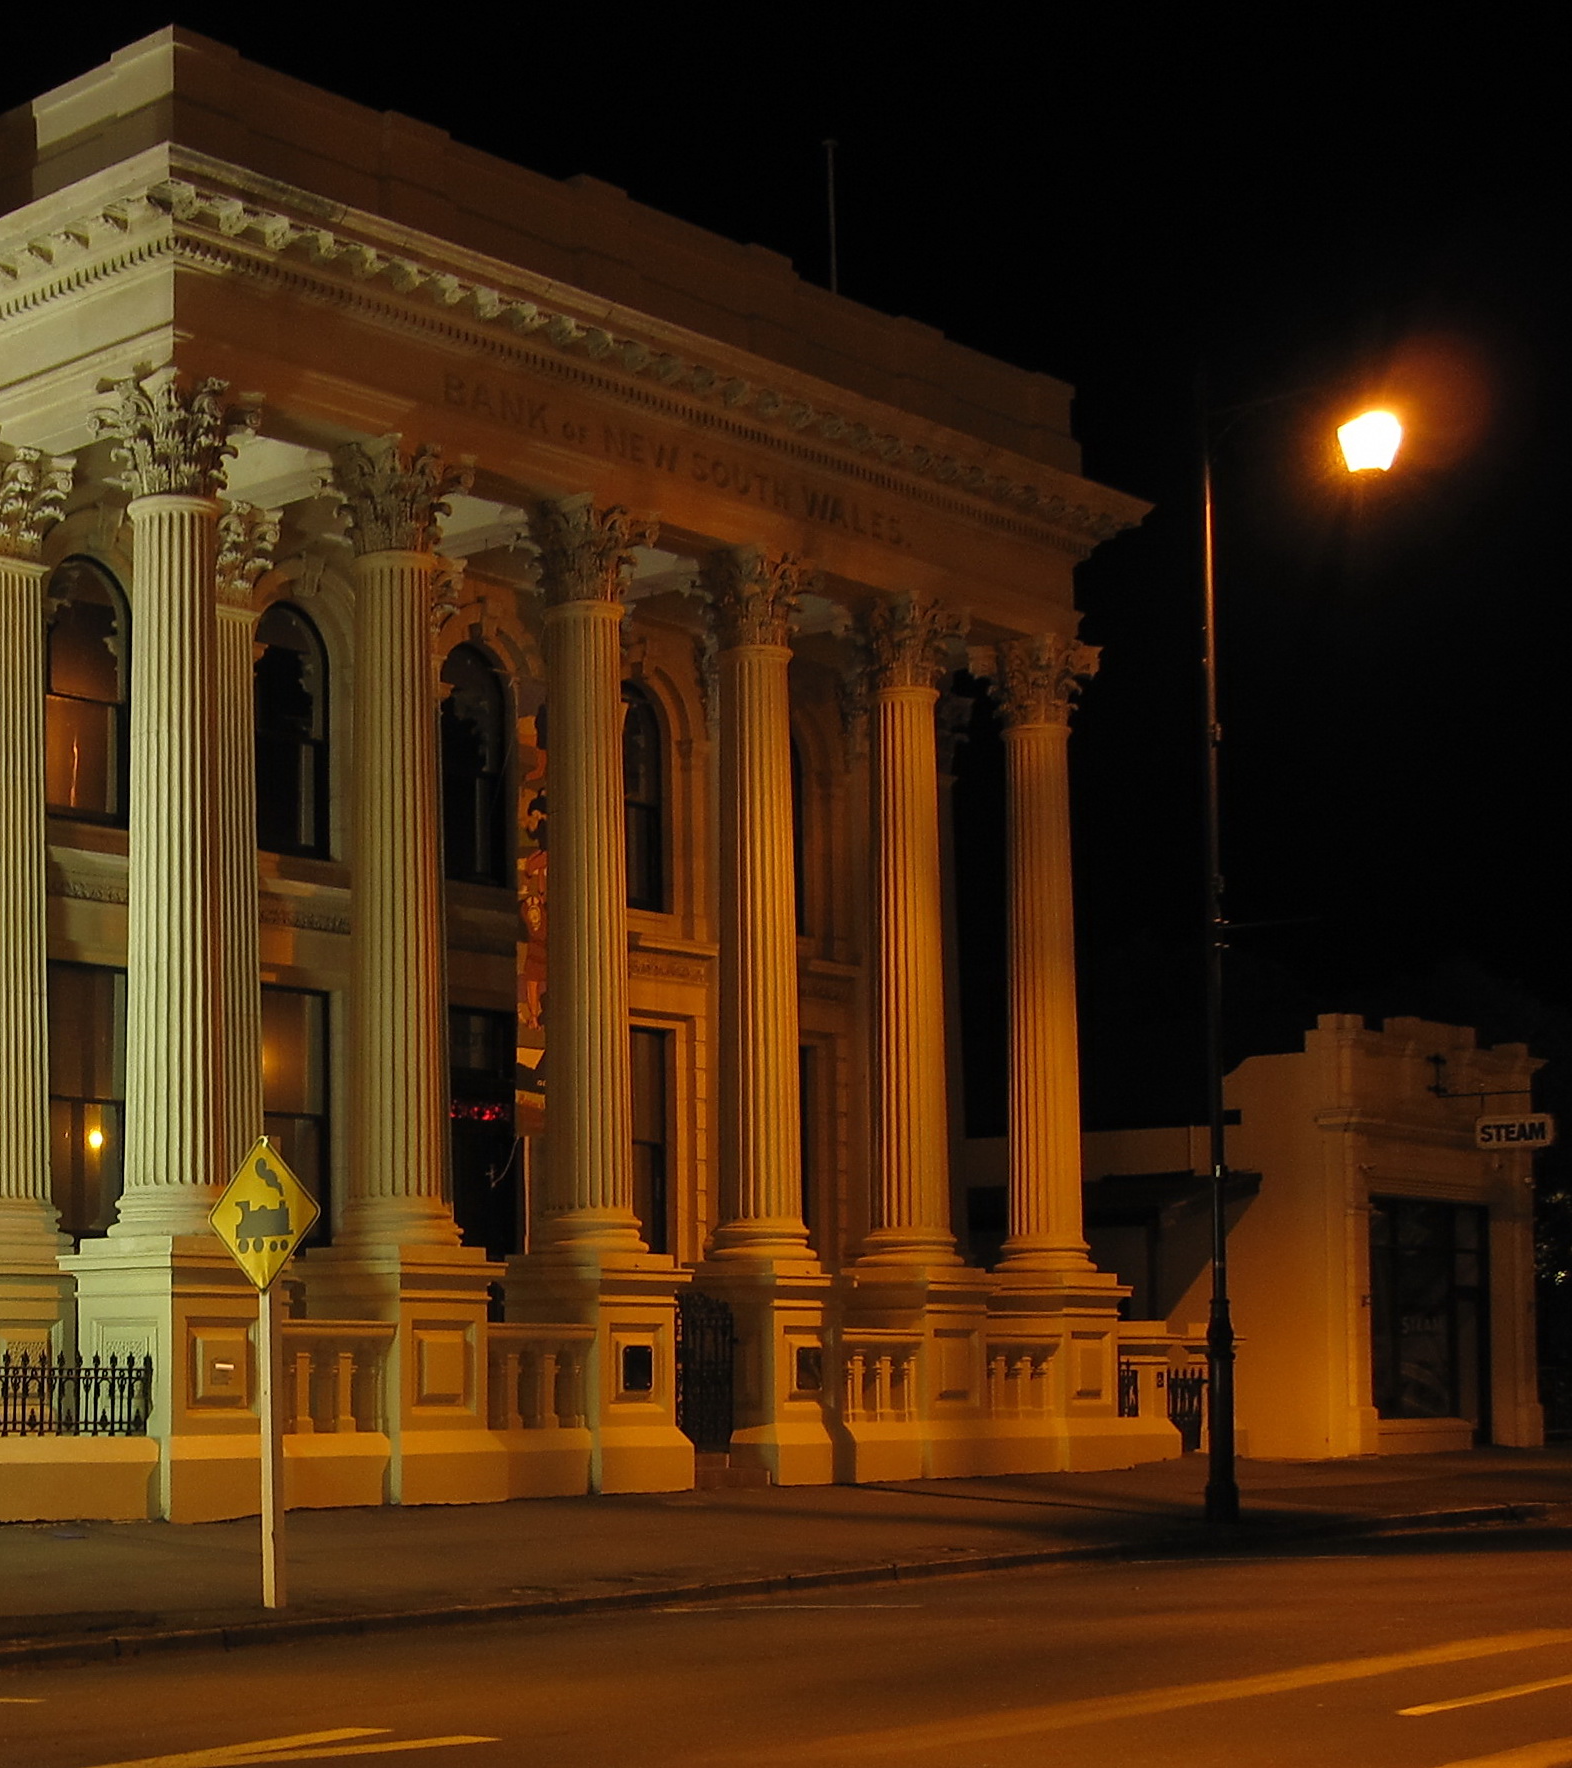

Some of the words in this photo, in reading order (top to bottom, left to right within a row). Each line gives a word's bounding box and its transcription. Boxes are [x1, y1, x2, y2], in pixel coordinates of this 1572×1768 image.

[443, 373, 551, 435] BANK
[602, 424, 681, 474] NEW
[691, 451, 791, 511] SOUTH
[1480, 1122, 1547, 1143] STEAM
